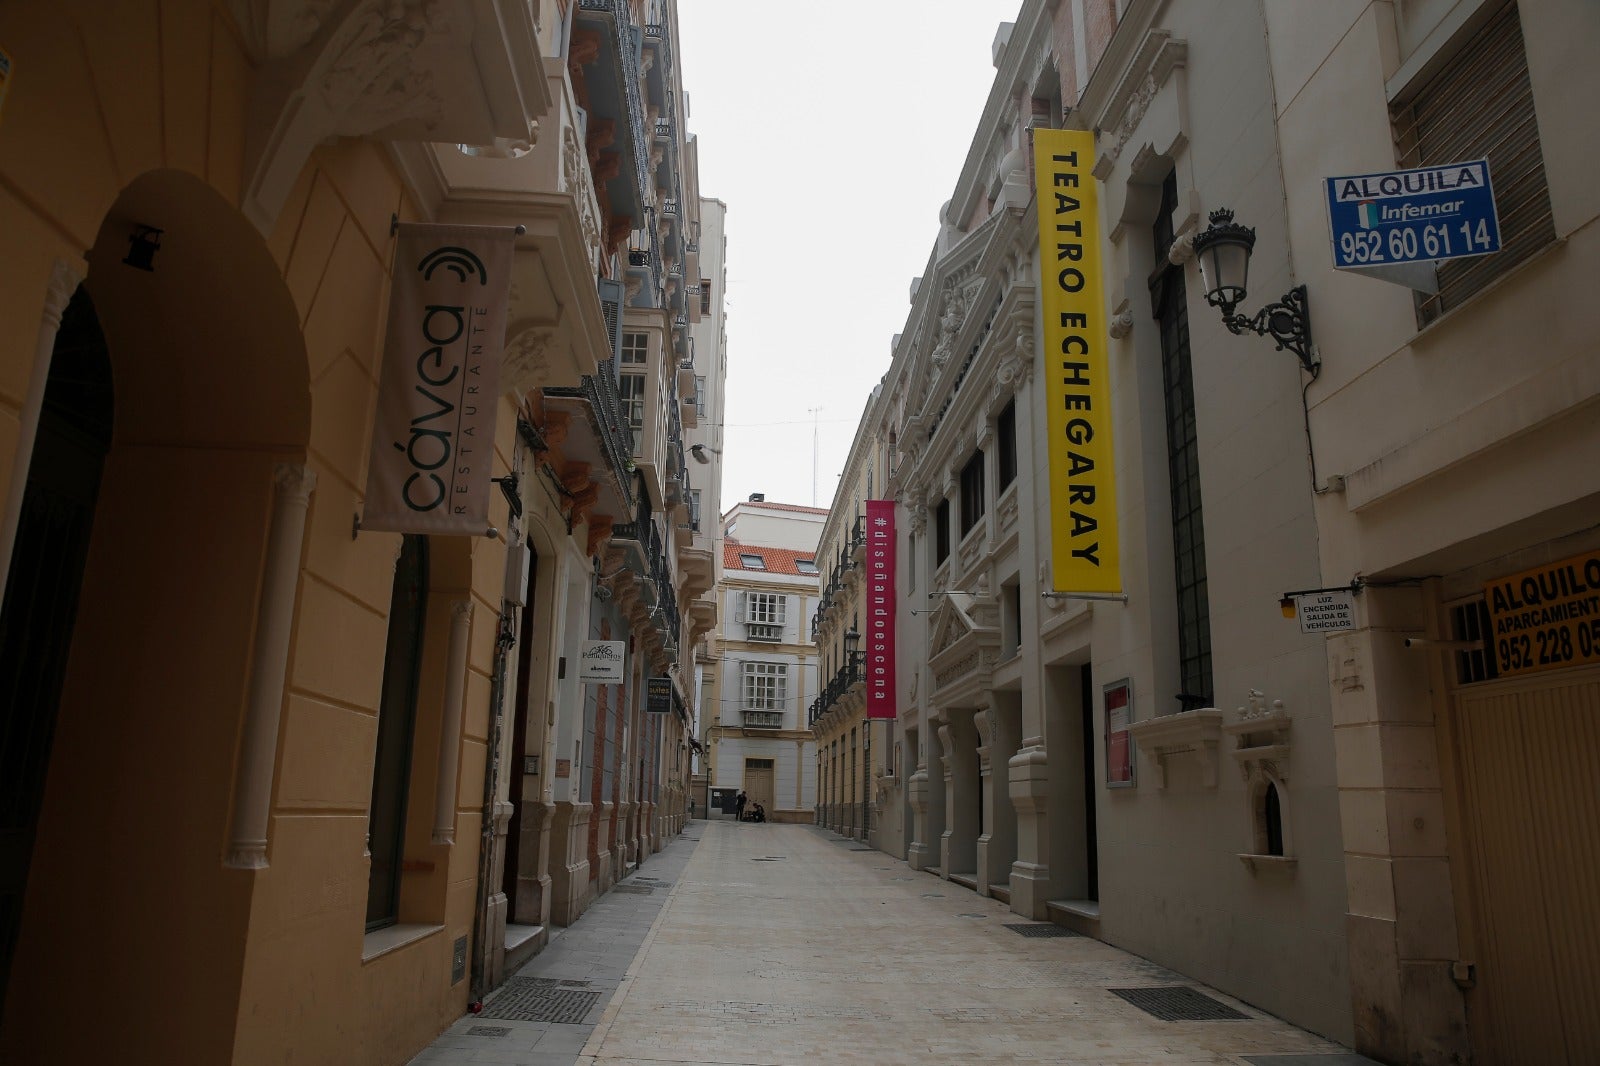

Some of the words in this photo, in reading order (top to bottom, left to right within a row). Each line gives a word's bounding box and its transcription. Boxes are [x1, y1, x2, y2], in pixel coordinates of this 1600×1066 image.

[1341, 167, 1479, 199] ALQUILA
[1052, 151, 1085, 293] TEATRO
[1381, 200, 1464, 221] Infemar
[1341, 230, 1384, 263] 952
[1389, 227, 1418, 259] 60
[1423, 223, 1451, 256] 61
[1460, 218, 1491, 251] 14
[393, 305, 465, 512] cávea
[454, 307, 487, 514] RESTAURANTE
[1060, 312, 1099, 567] ECHEGARAY
[874, 517, 887, 699] #diseñandoescena
[1303, 603, 1349, 613] ENCENDIDA
[1317, 596, 1333, 604] LUZ
[1492, 558, 1600, 614] ALQUILO
[1306, 613, 1335, 621] SALIDA
[1306, 620, 1351, 629] VEHÍCULOS
[1499, 634, 1533, 671] 952
[1536, 625, 1574, 664] 228
